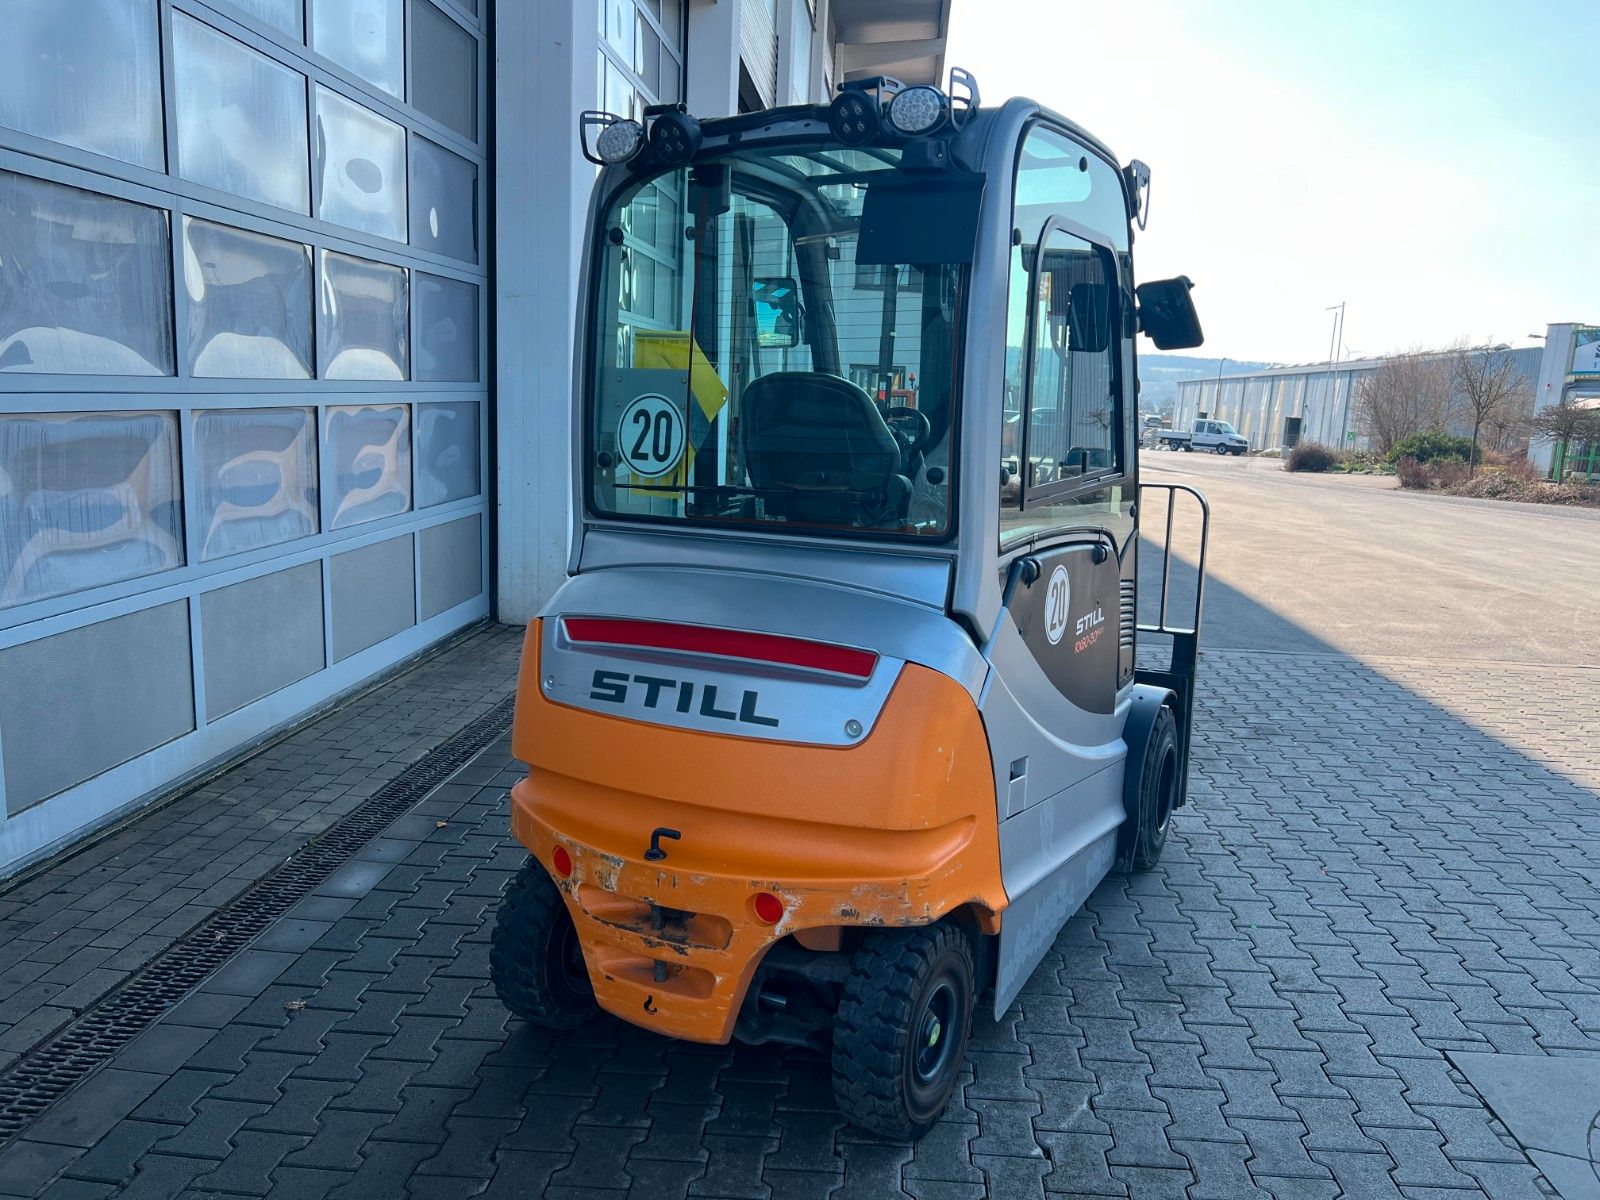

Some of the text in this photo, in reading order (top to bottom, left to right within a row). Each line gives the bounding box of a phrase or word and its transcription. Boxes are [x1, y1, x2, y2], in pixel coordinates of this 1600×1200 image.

[630, 408, 673, 463] 20
[1049, 579, 1066, 631] 20
[1075, 607, 1105, 636] STILL
[590, 669, 780, 728] STILL
